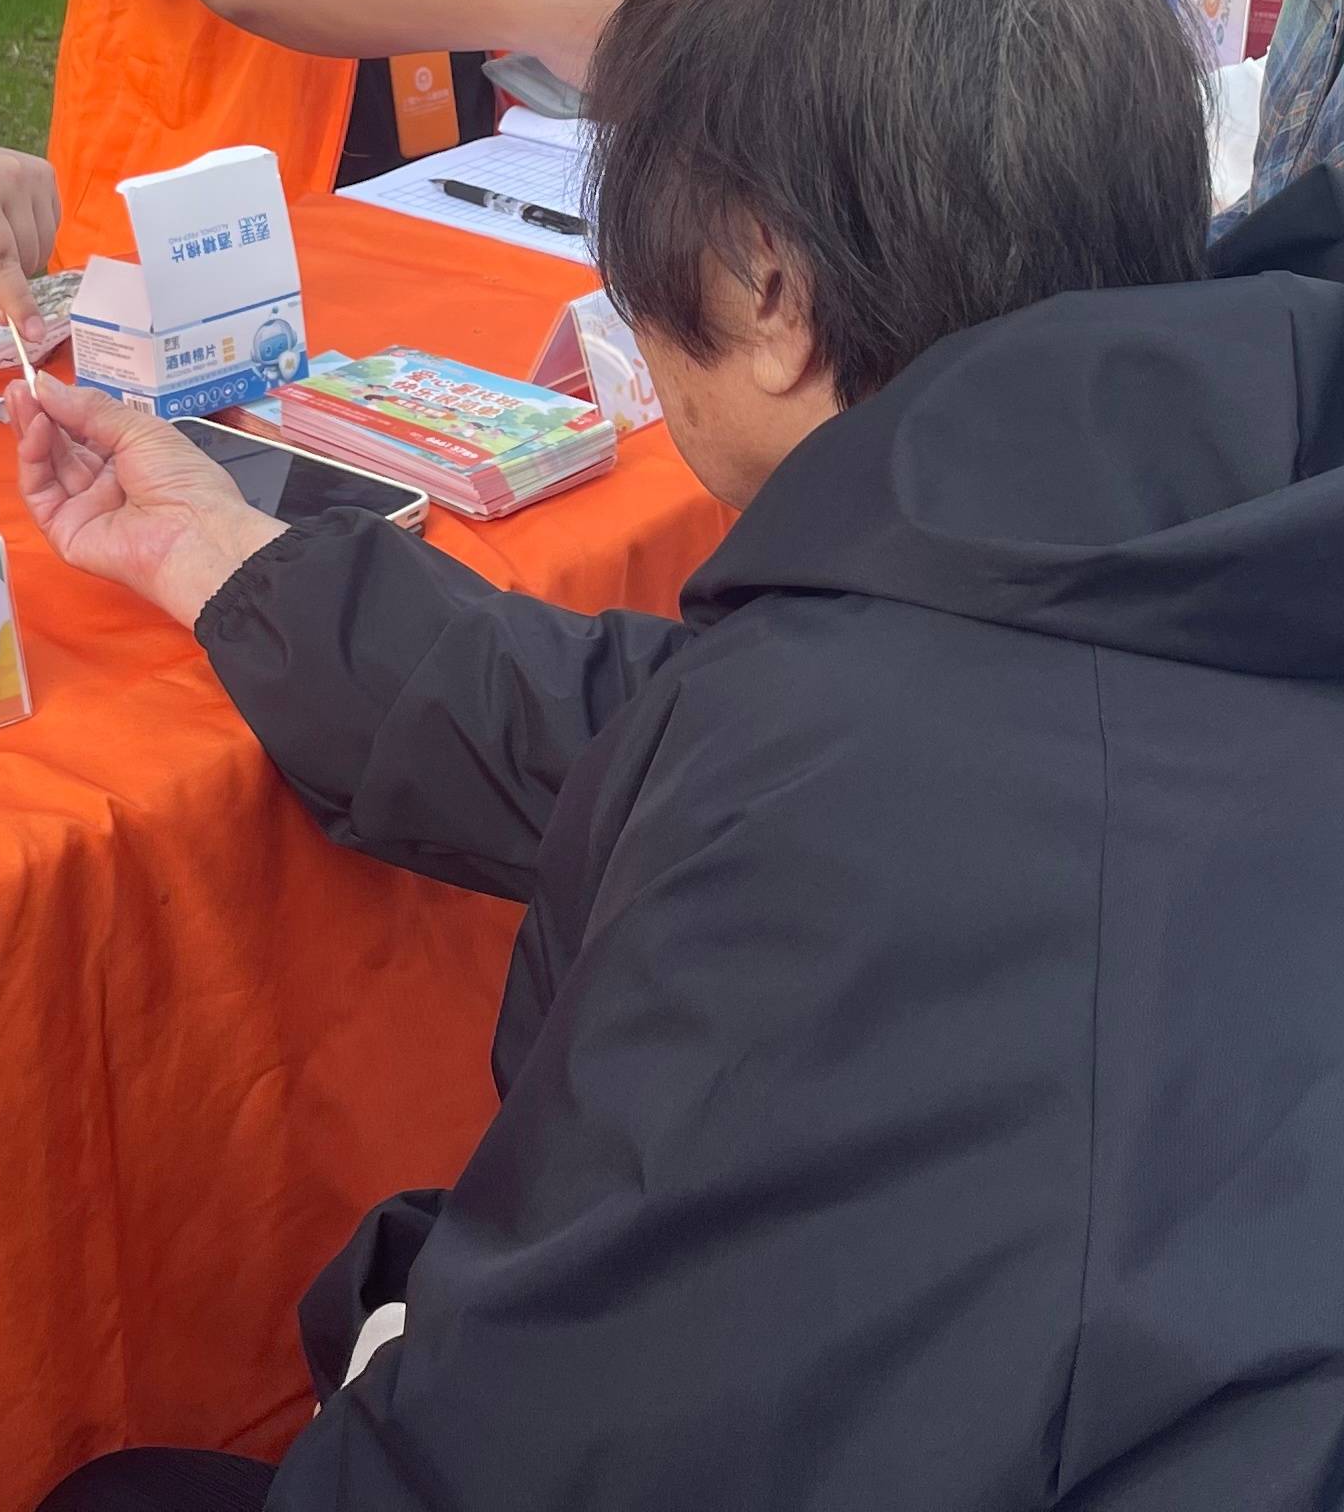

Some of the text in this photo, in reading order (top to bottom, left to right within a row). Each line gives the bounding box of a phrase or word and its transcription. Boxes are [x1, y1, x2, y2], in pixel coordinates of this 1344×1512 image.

[171, 231, 233, 263] 酒精棉片
[166, 344, 217, 371] 酒精棉片
